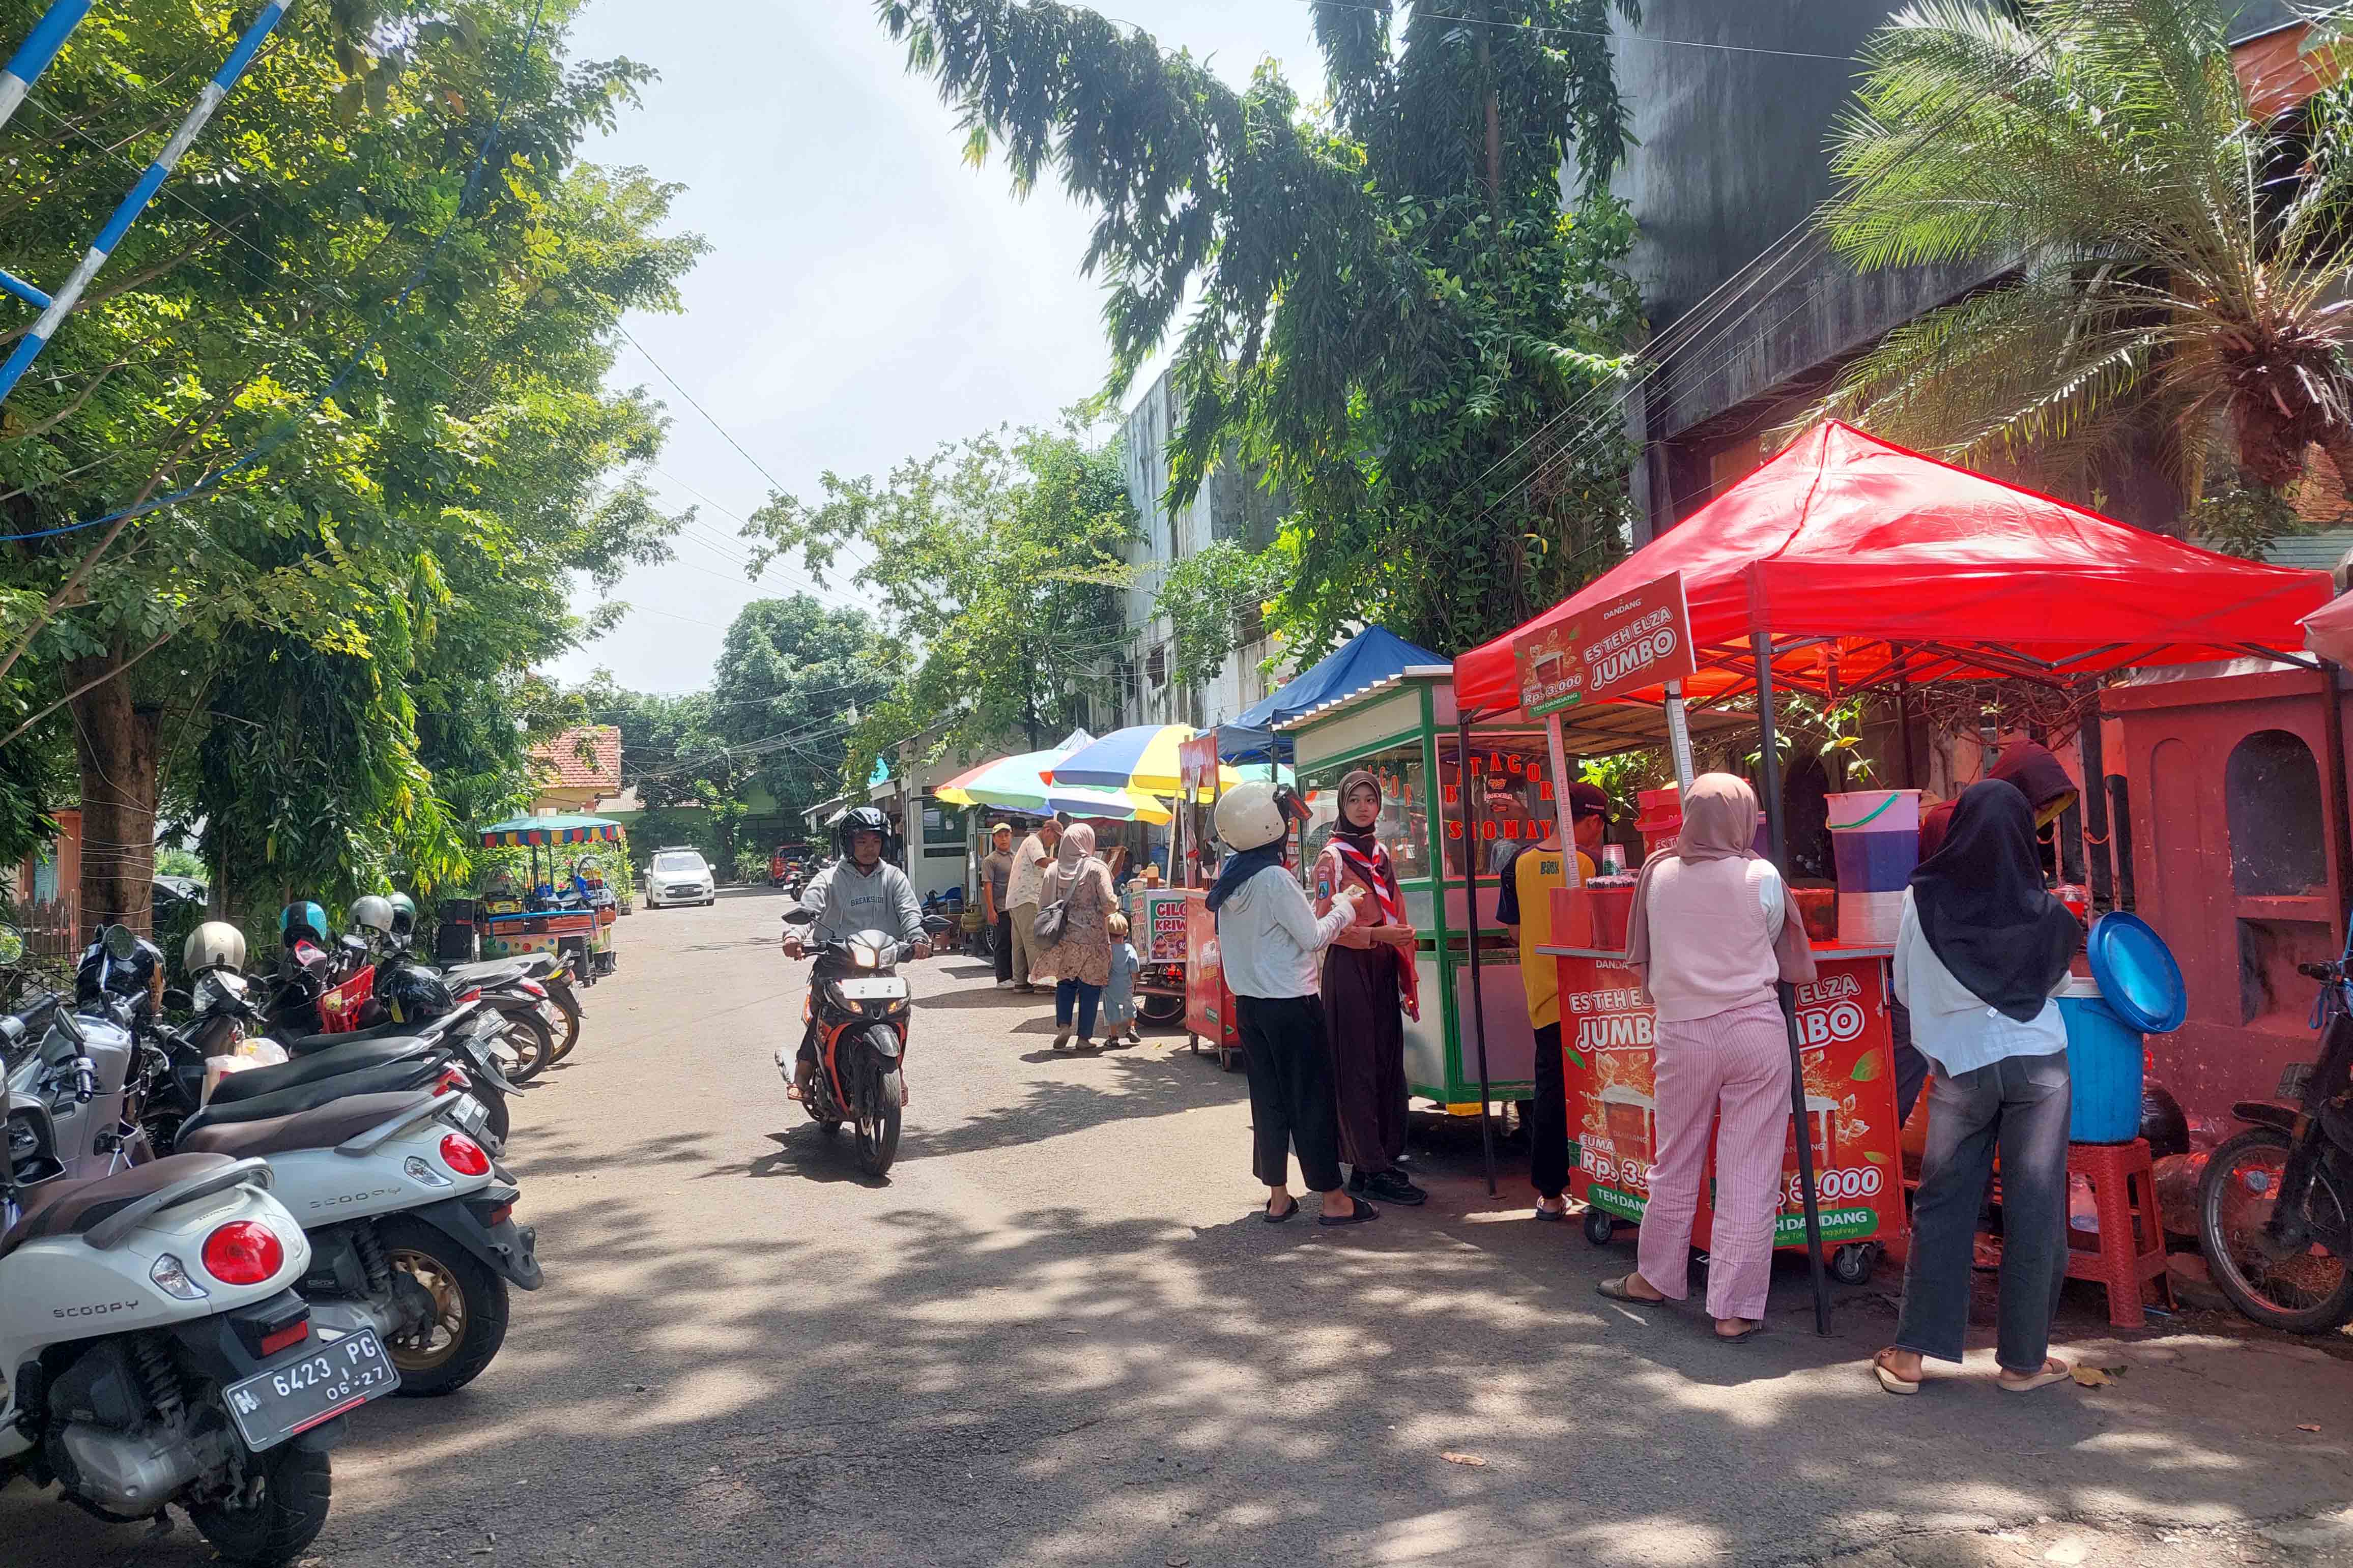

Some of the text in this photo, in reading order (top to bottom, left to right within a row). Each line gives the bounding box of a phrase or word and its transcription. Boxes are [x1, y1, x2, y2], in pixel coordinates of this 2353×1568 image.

[1603, 599, 1641, 620] DANDANG
[1584, 607, 1672, 662] ES TEH ELZA
[1592, 629, 1675, 689] JUMBO
[1546, 674, 1583, 695] 3.000
[1545, 692, 1578, 708] DANDANG
[1798, 976, 1859, 1003] ELZA
[1571, 995, 1591, 1011] ES
[1592, 991, 1627, 1009] TEH
[1579, 1017, 1658, 1049] JUMB
[1583, 1150, 1617, 1179] Rp.
[309, 1187, 401, 1209] SCOOPY
[1596, 1188, 1618, 1204] TEH
[53, 1299, 138, 1318] SCOOPY
[273, 1357, 331, 1396] 6423
[346, 1337, 376, 1364] PG
